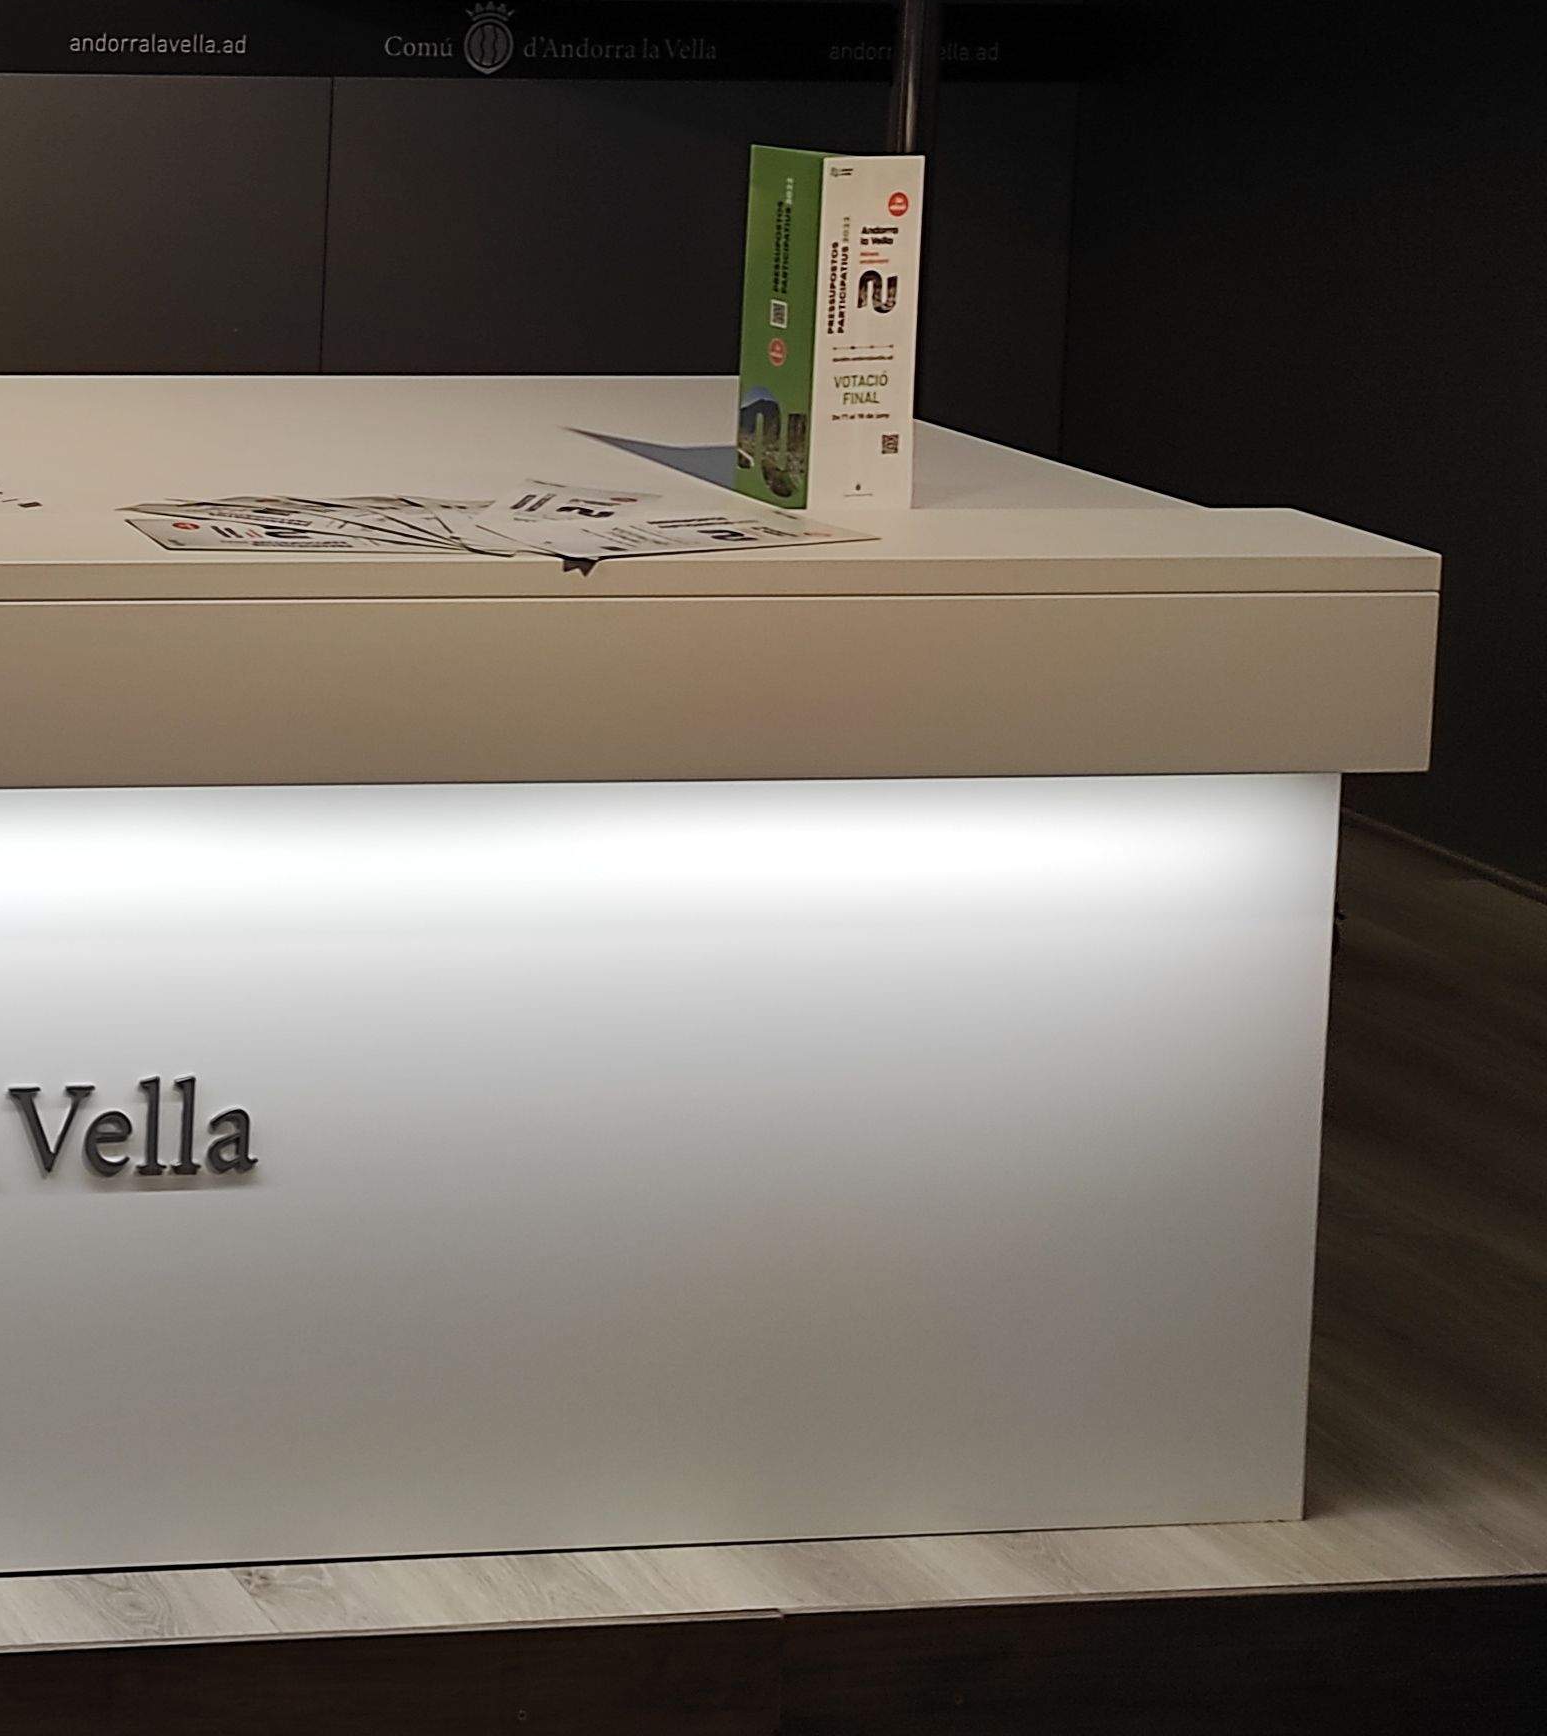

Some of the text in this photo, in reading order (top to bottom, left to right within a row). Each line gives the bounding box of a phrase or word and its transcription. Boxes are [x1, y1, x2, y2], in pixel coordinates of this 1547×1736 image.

[69, 33, 246, 56] andorralavella.ad
[384, 35, 453, 58] Comú
[641, 38, 660, 61] la
[664, 38, 717, 61] Vella
[834, 371, 888, 388] VOTACIÓ
[843, 393, 880, 405] FINAL
[10, 1075, 260, 1178] Vella
